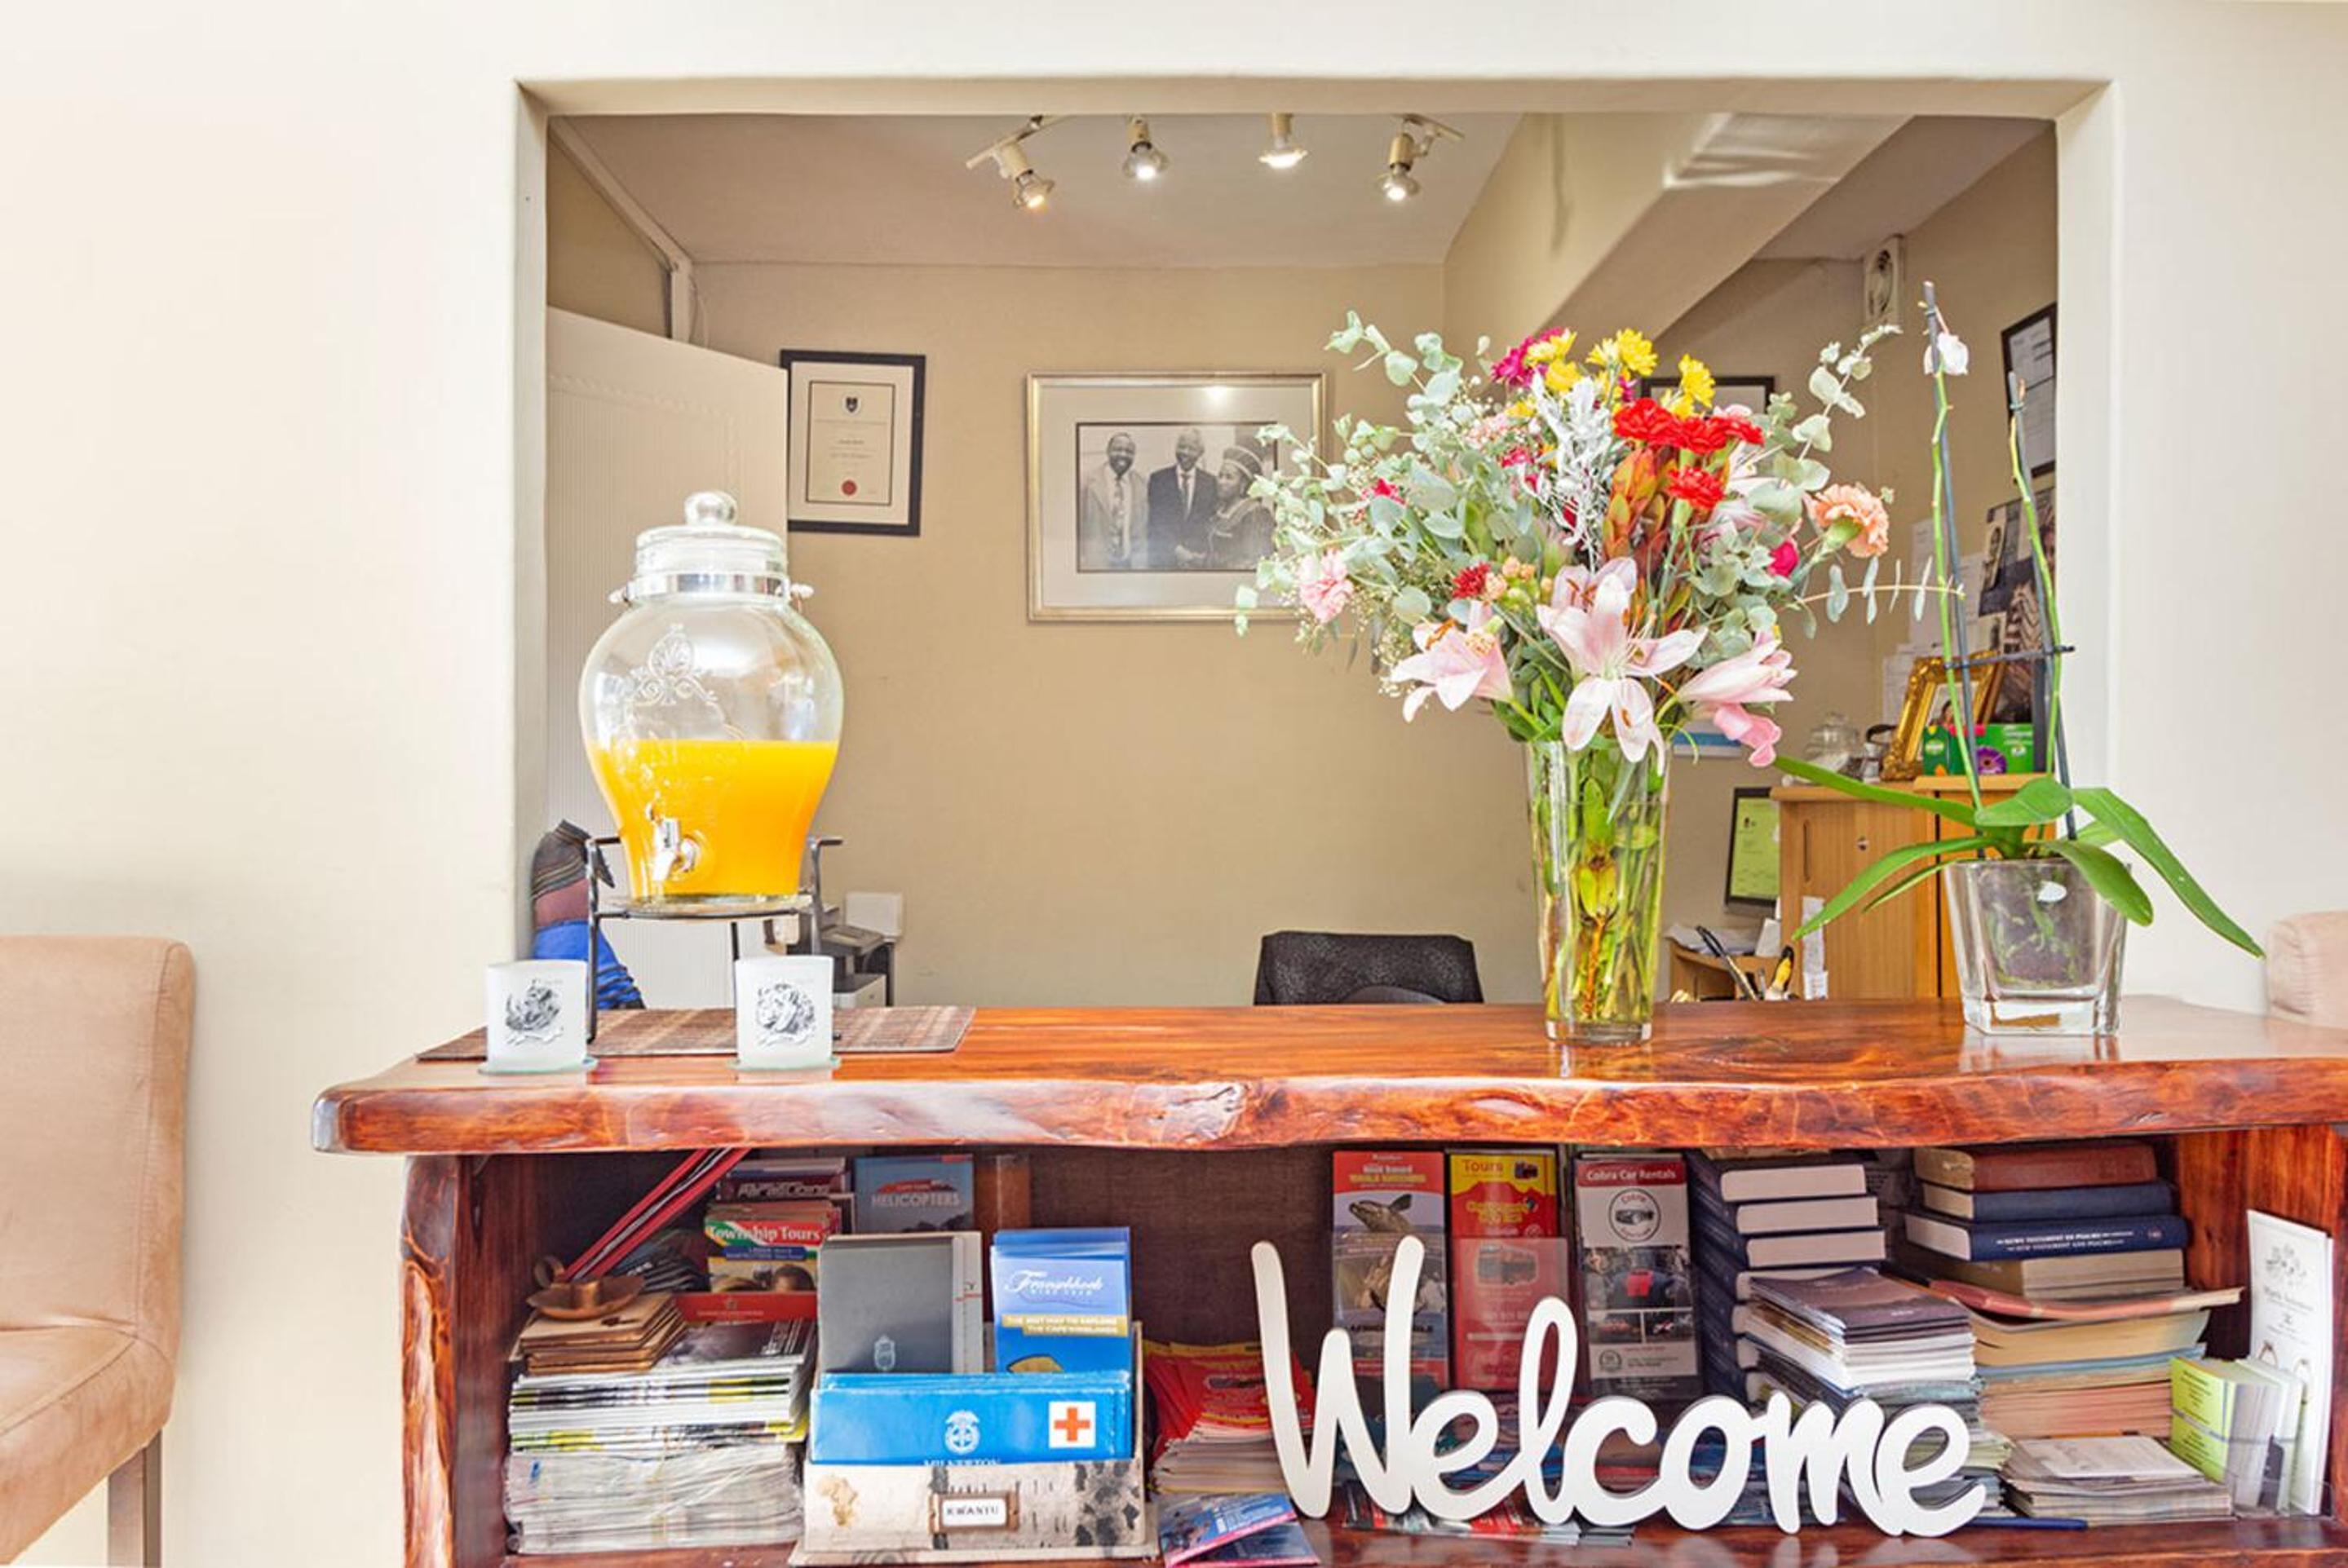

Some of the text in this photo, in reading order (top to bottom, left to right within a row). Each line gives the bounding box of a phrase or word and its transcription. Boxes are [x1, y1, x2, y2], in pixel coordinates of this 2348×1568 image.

[1461, 1159, 1504, 1173] Tours
[1586, 1168, 1677, 1181] Cobra Car Rentals
[871, 1192, 961, 1208] HELICOPTERS
[709, 1225, 820, 1243] Township Tours
[1251, 1235, 1984, 1536] Welcome
